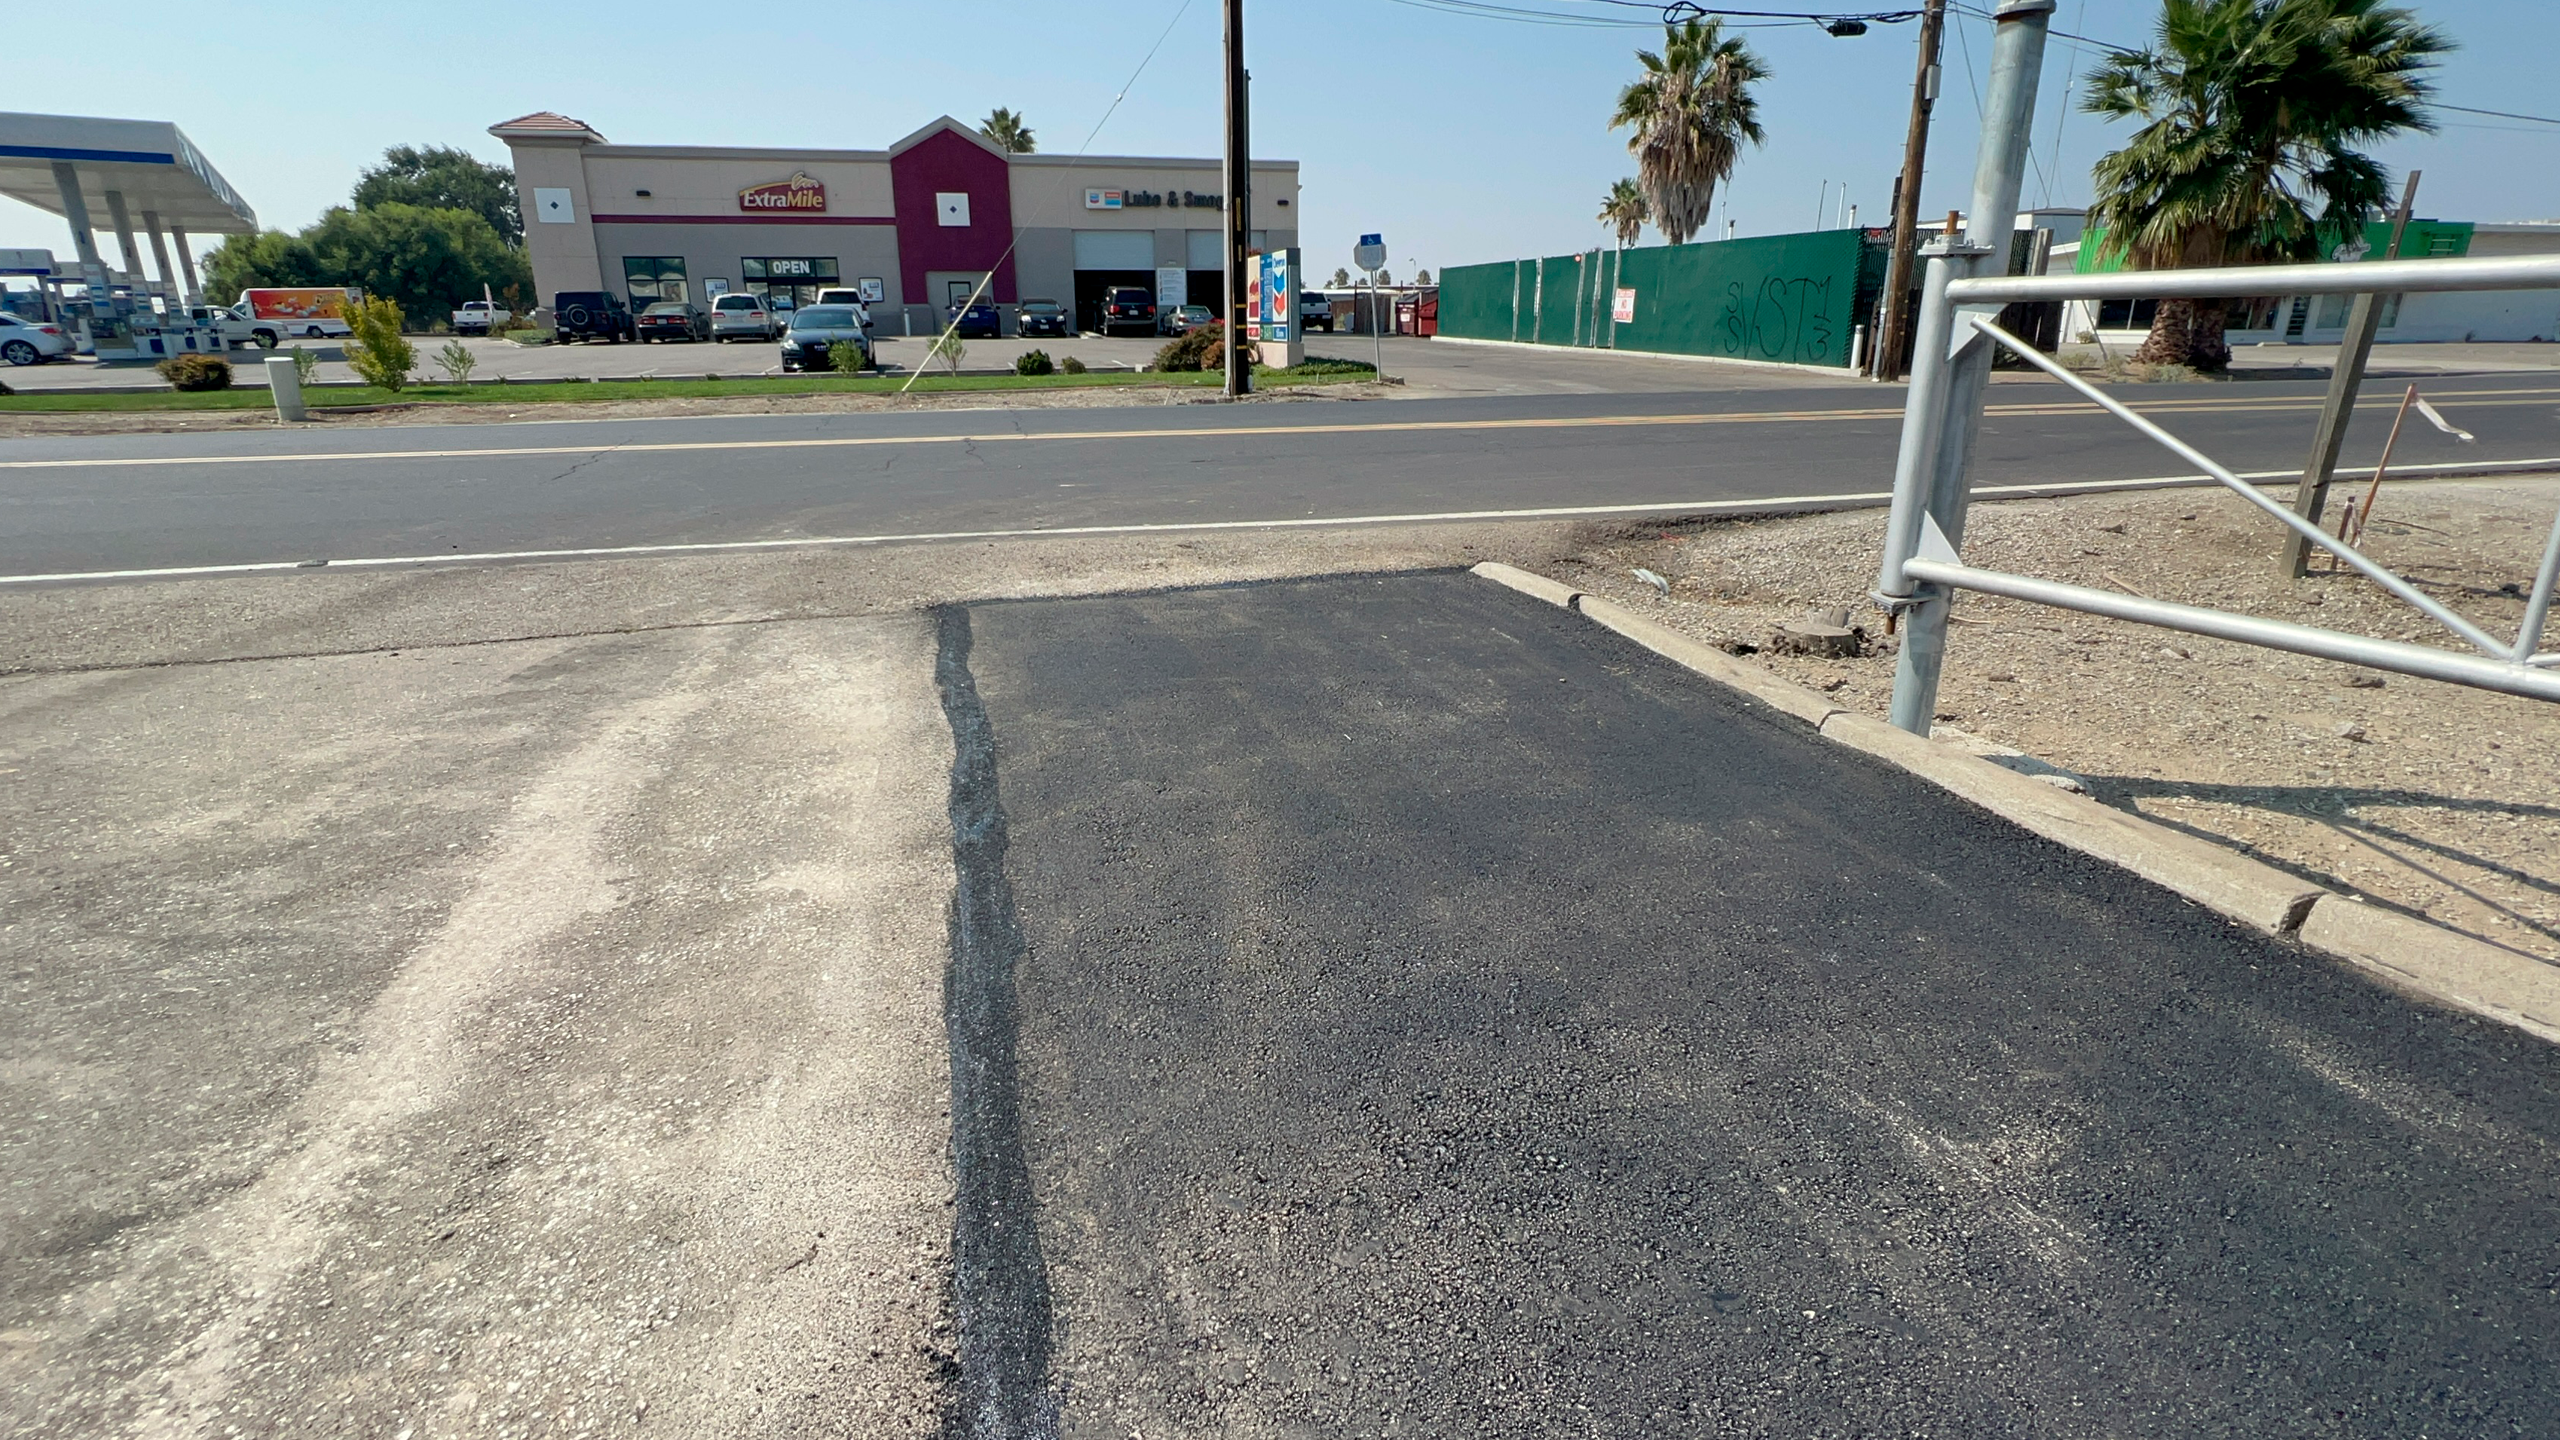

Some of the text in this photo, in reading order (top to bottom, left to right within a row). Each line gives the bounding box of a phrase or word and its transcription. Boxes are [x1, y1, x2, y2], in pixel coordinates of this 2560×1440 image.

[743, 190, 824, 208] ExtraMile
[1124, 190, 1224, 211] Lube & Smog
[772, 260, 811, 275] OPEN
